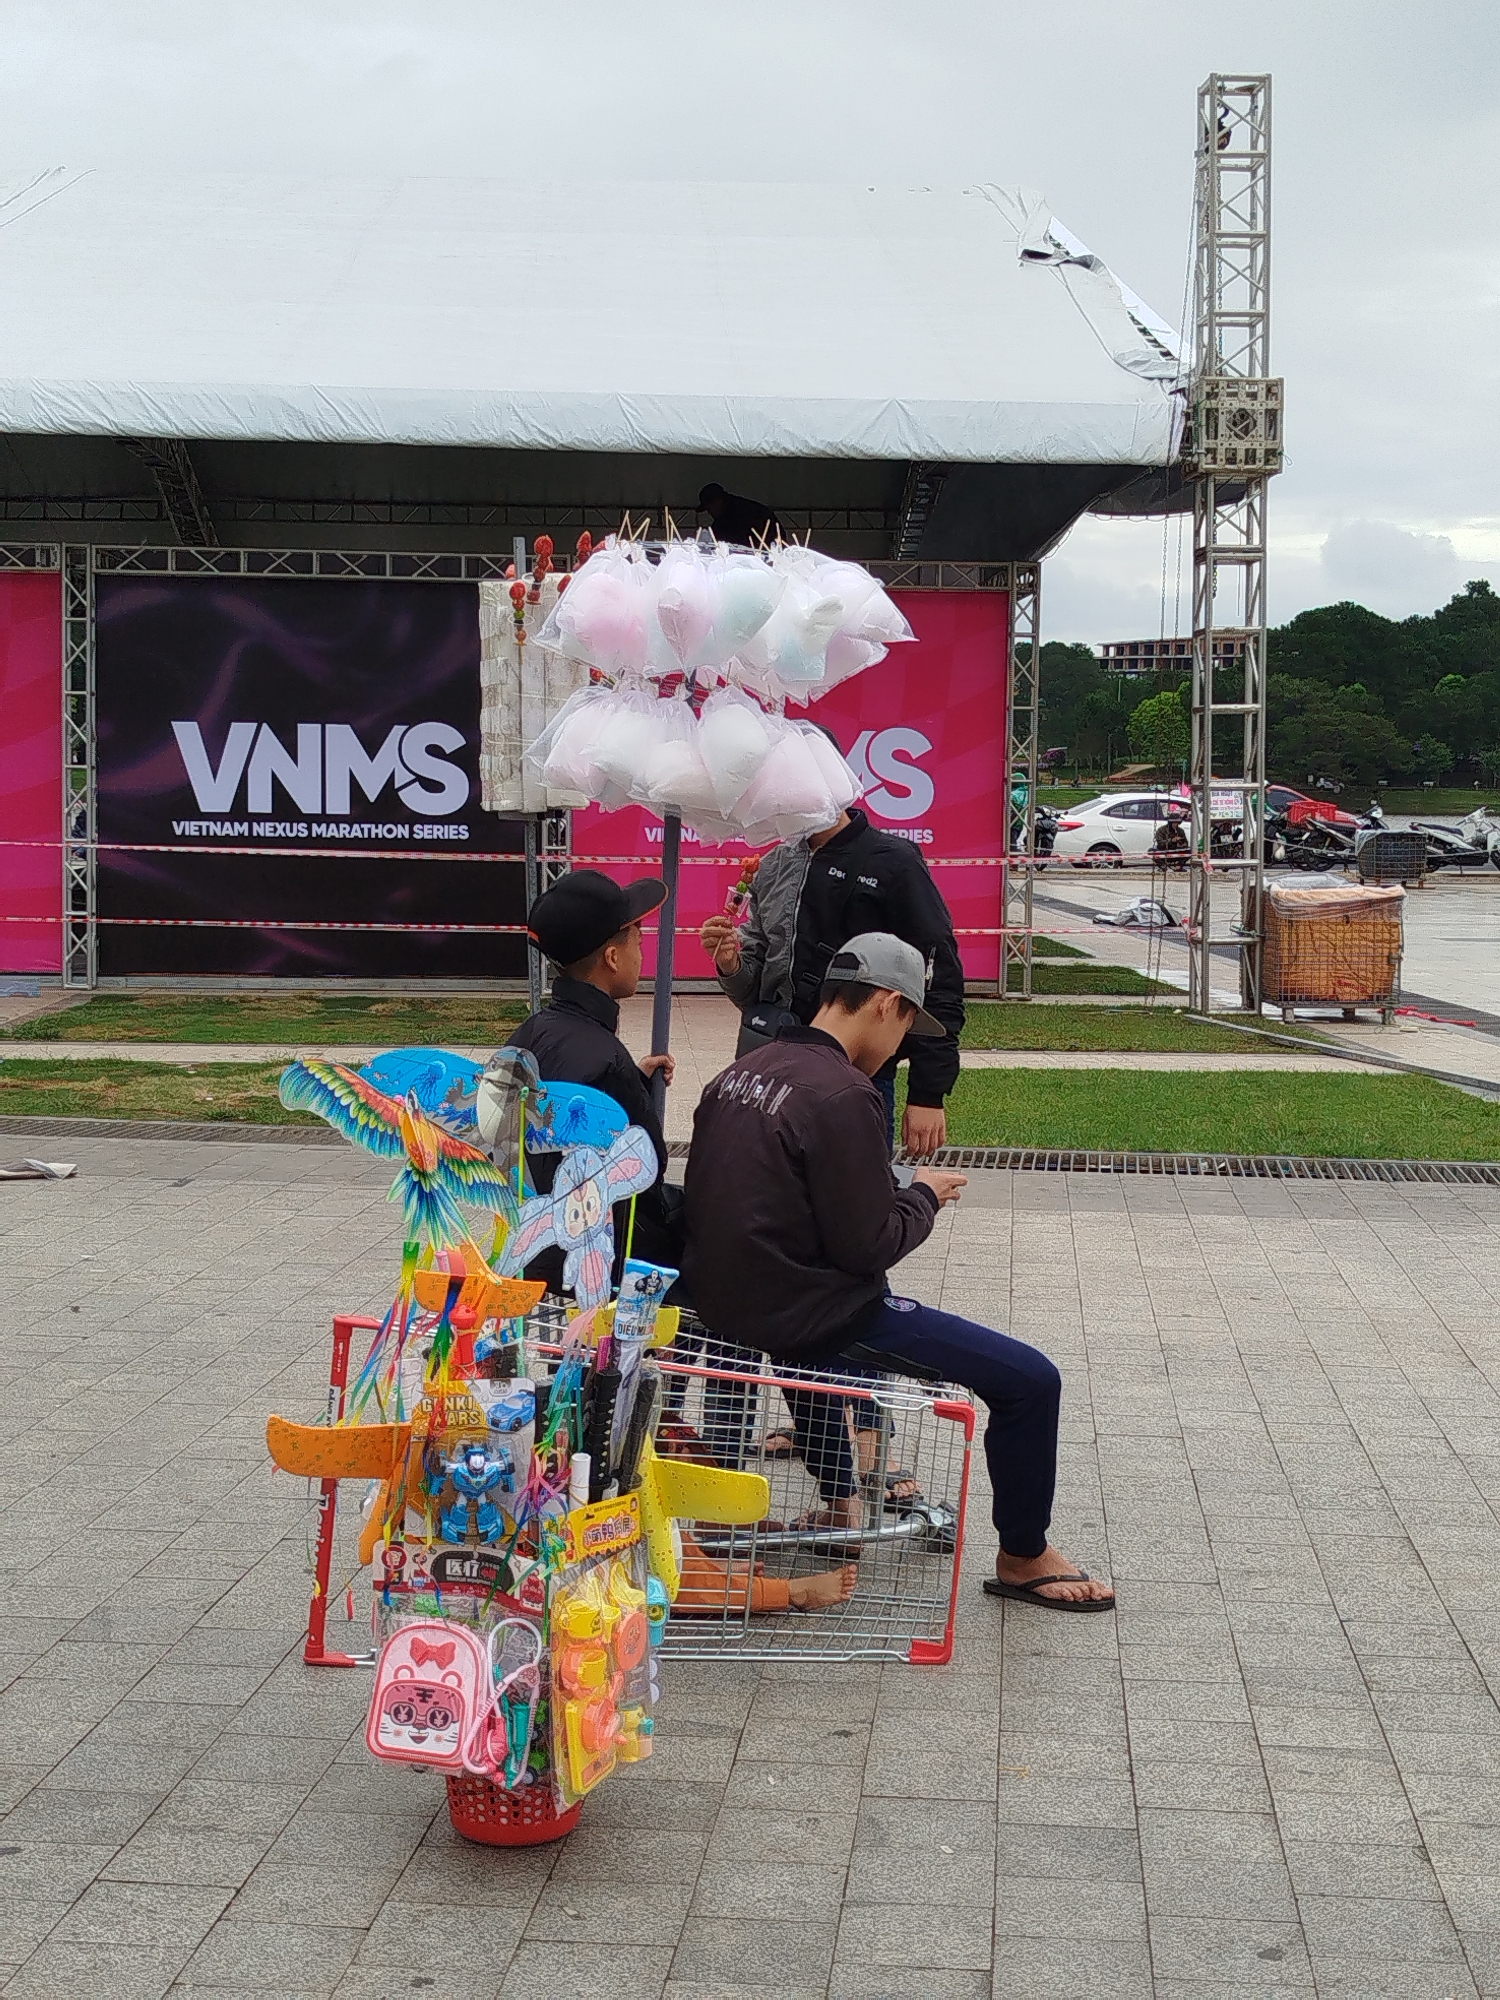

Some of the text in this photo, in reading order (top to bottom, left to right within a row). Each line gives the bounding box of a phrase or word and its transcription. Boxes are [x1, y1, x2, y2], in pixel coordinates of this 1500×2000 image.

[170, 721, 470, 816] VNMS
[172, 820, 470, 840] VIETNAM NEXUS MARATHON SERIES
